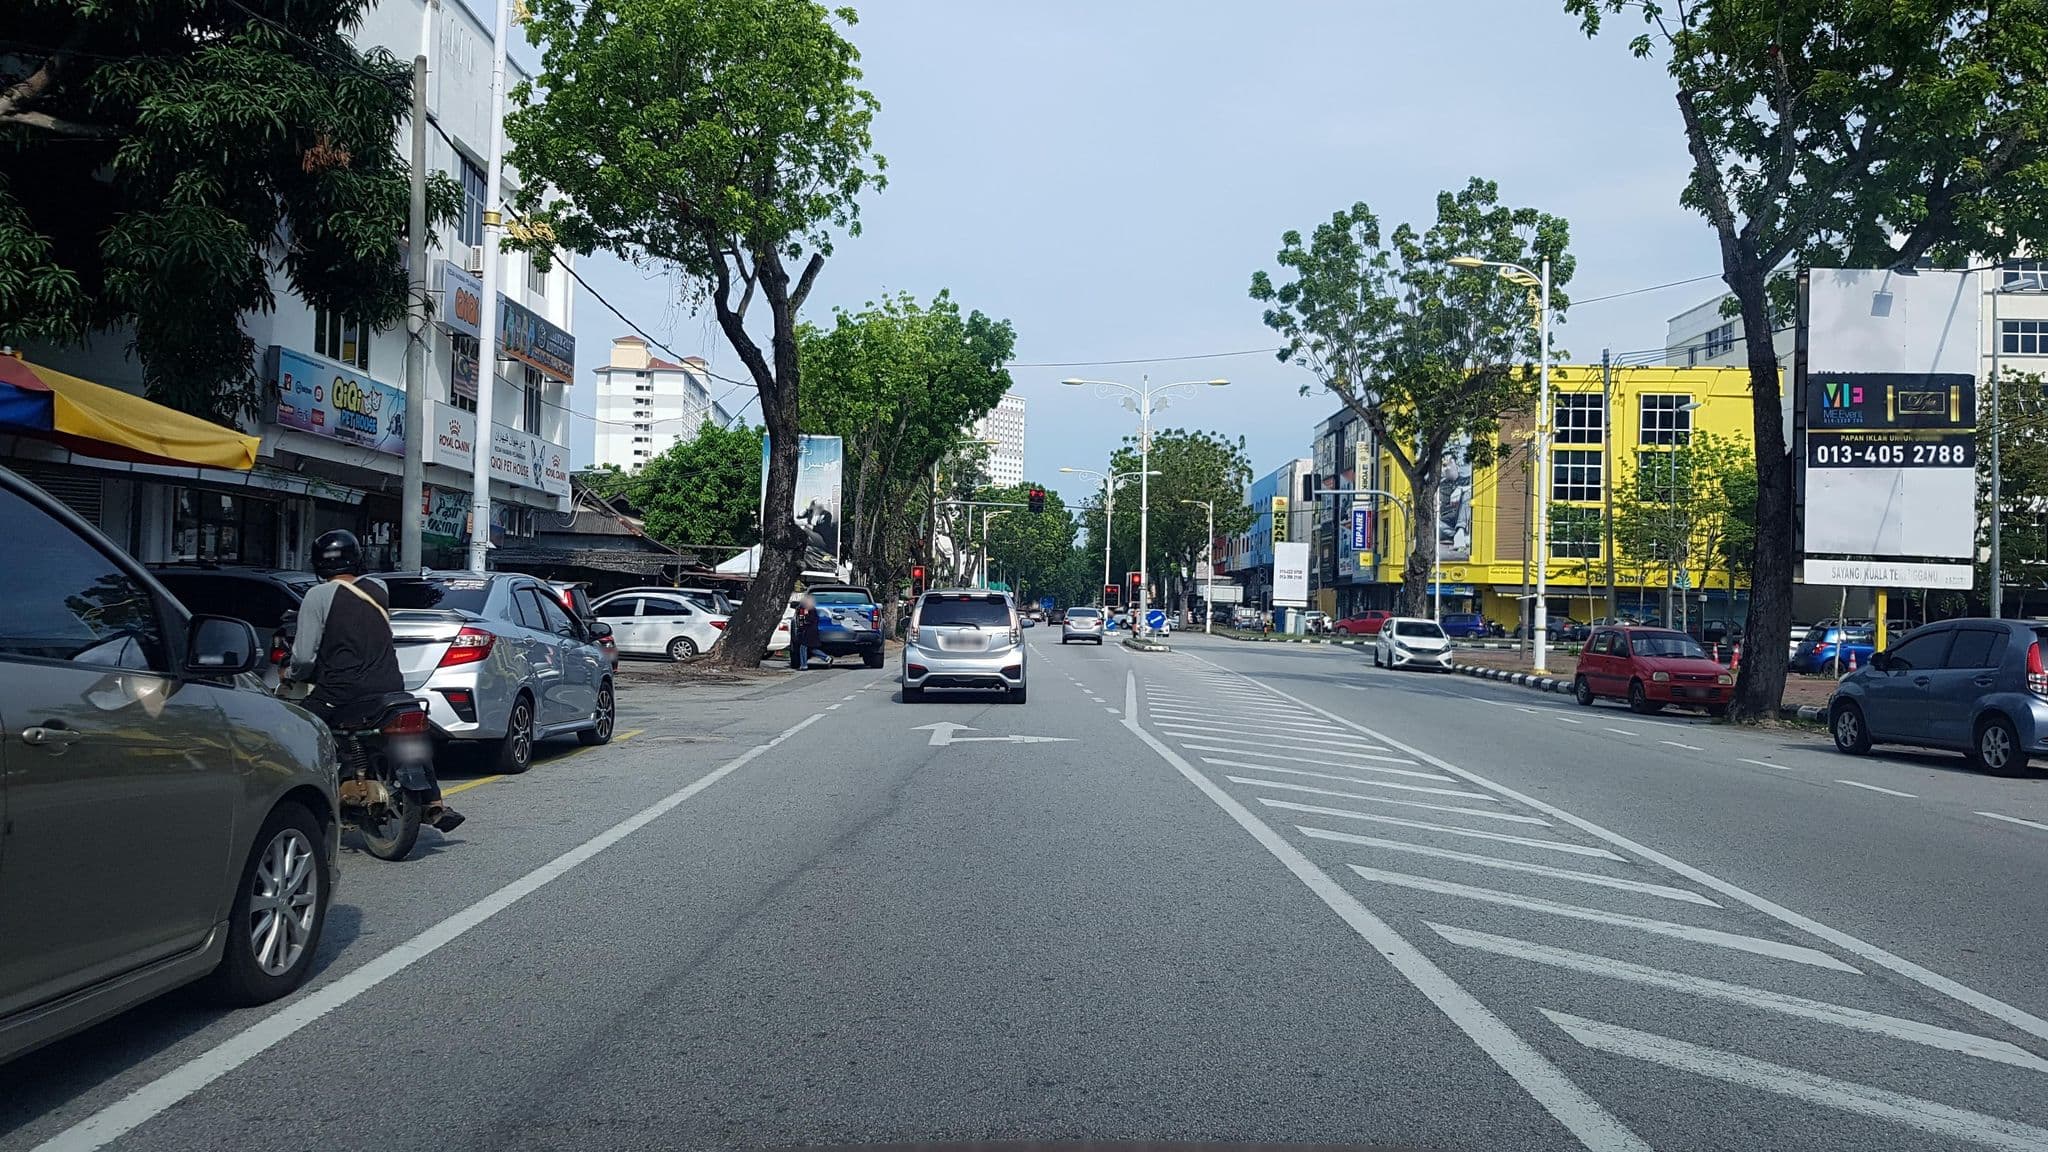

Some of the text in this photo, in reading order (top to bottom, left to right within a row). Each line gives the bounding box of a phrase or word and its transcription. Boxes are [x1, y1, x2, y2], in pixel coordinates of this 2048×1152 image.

[332, 375, 362, 411] QiQi
[341, 409, 356, 428] PET
[355, 412, 377, 434] HOUSE
[1840, 434, 1865, 442] PAPAN
[1817, 445, 1965, 463] 013-405 2788
[503, 459, 512, 472] PET
[512, 463, 529, 477] HOUSE
[1355, 513, 1364, 547] TOPAIRE
[1863, 569, 1888, 581] KUALA
